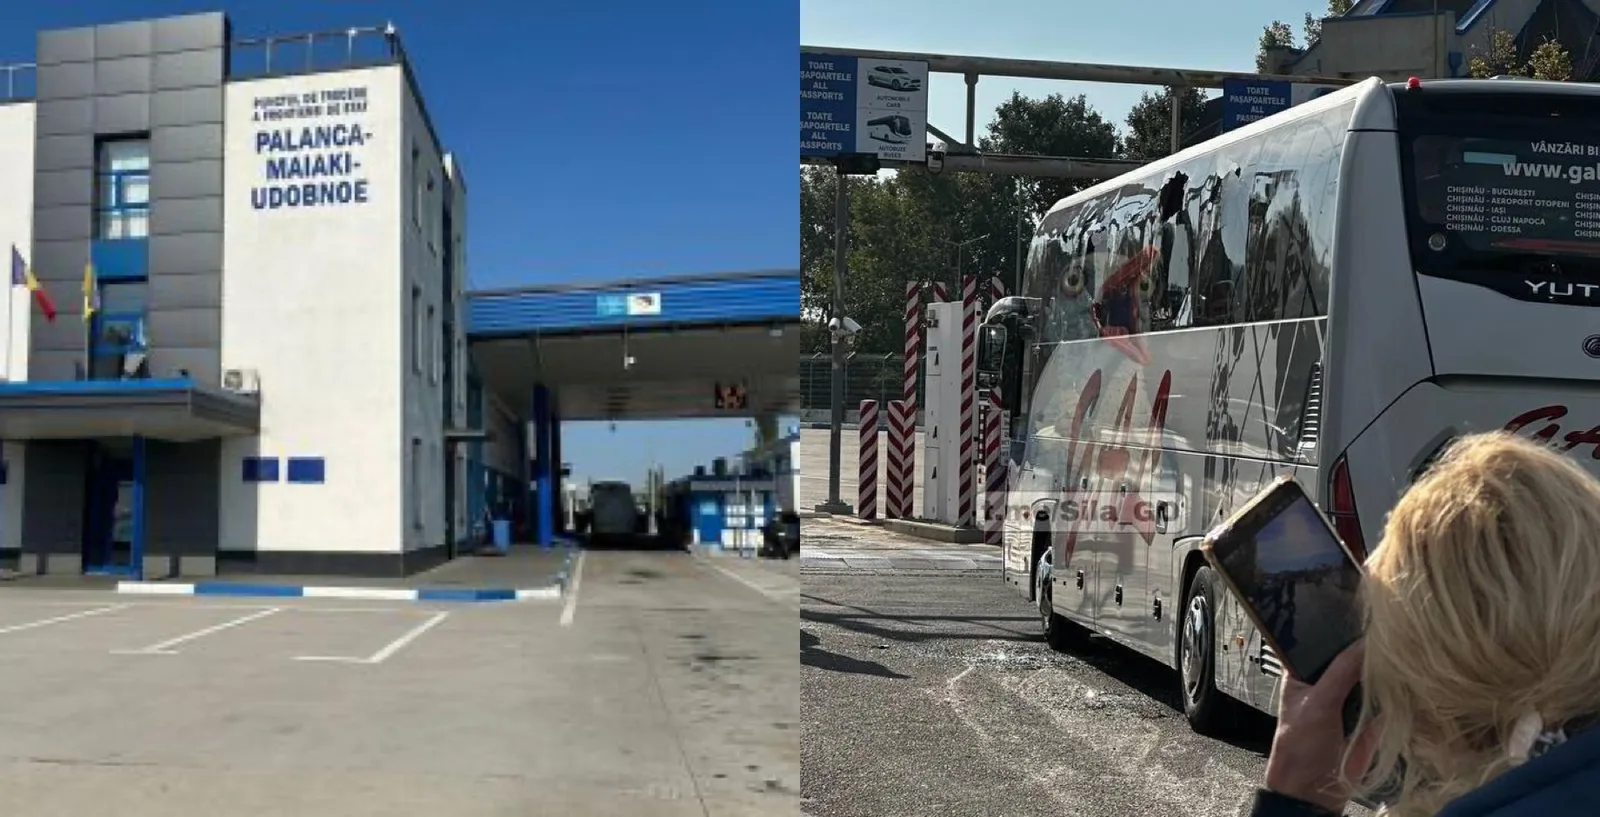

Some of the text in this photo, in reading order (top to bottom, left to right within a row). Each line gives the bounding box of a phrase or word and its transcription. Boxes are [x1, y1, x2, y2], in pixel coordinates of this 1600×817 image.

[808, 61, 834, 70] TOATE
[812, 82, 828, 90] ALL
[1246, 87, 1270, 96] TOATE
[806, 112, 832, 121] TOATE
[256, 124, 373, 154] PALANCA-
[812, 132, 827, 140] ALL
[1531, 140, 1584, 155] VÂNZĂRI
[266, 151, 361, 179] MAIAKI-
[251, 179, 368, 209] UDOBNOE
[1535, 200, 1570, 208] OTOPENI
[1524, 280, 1600, 298] YUT
